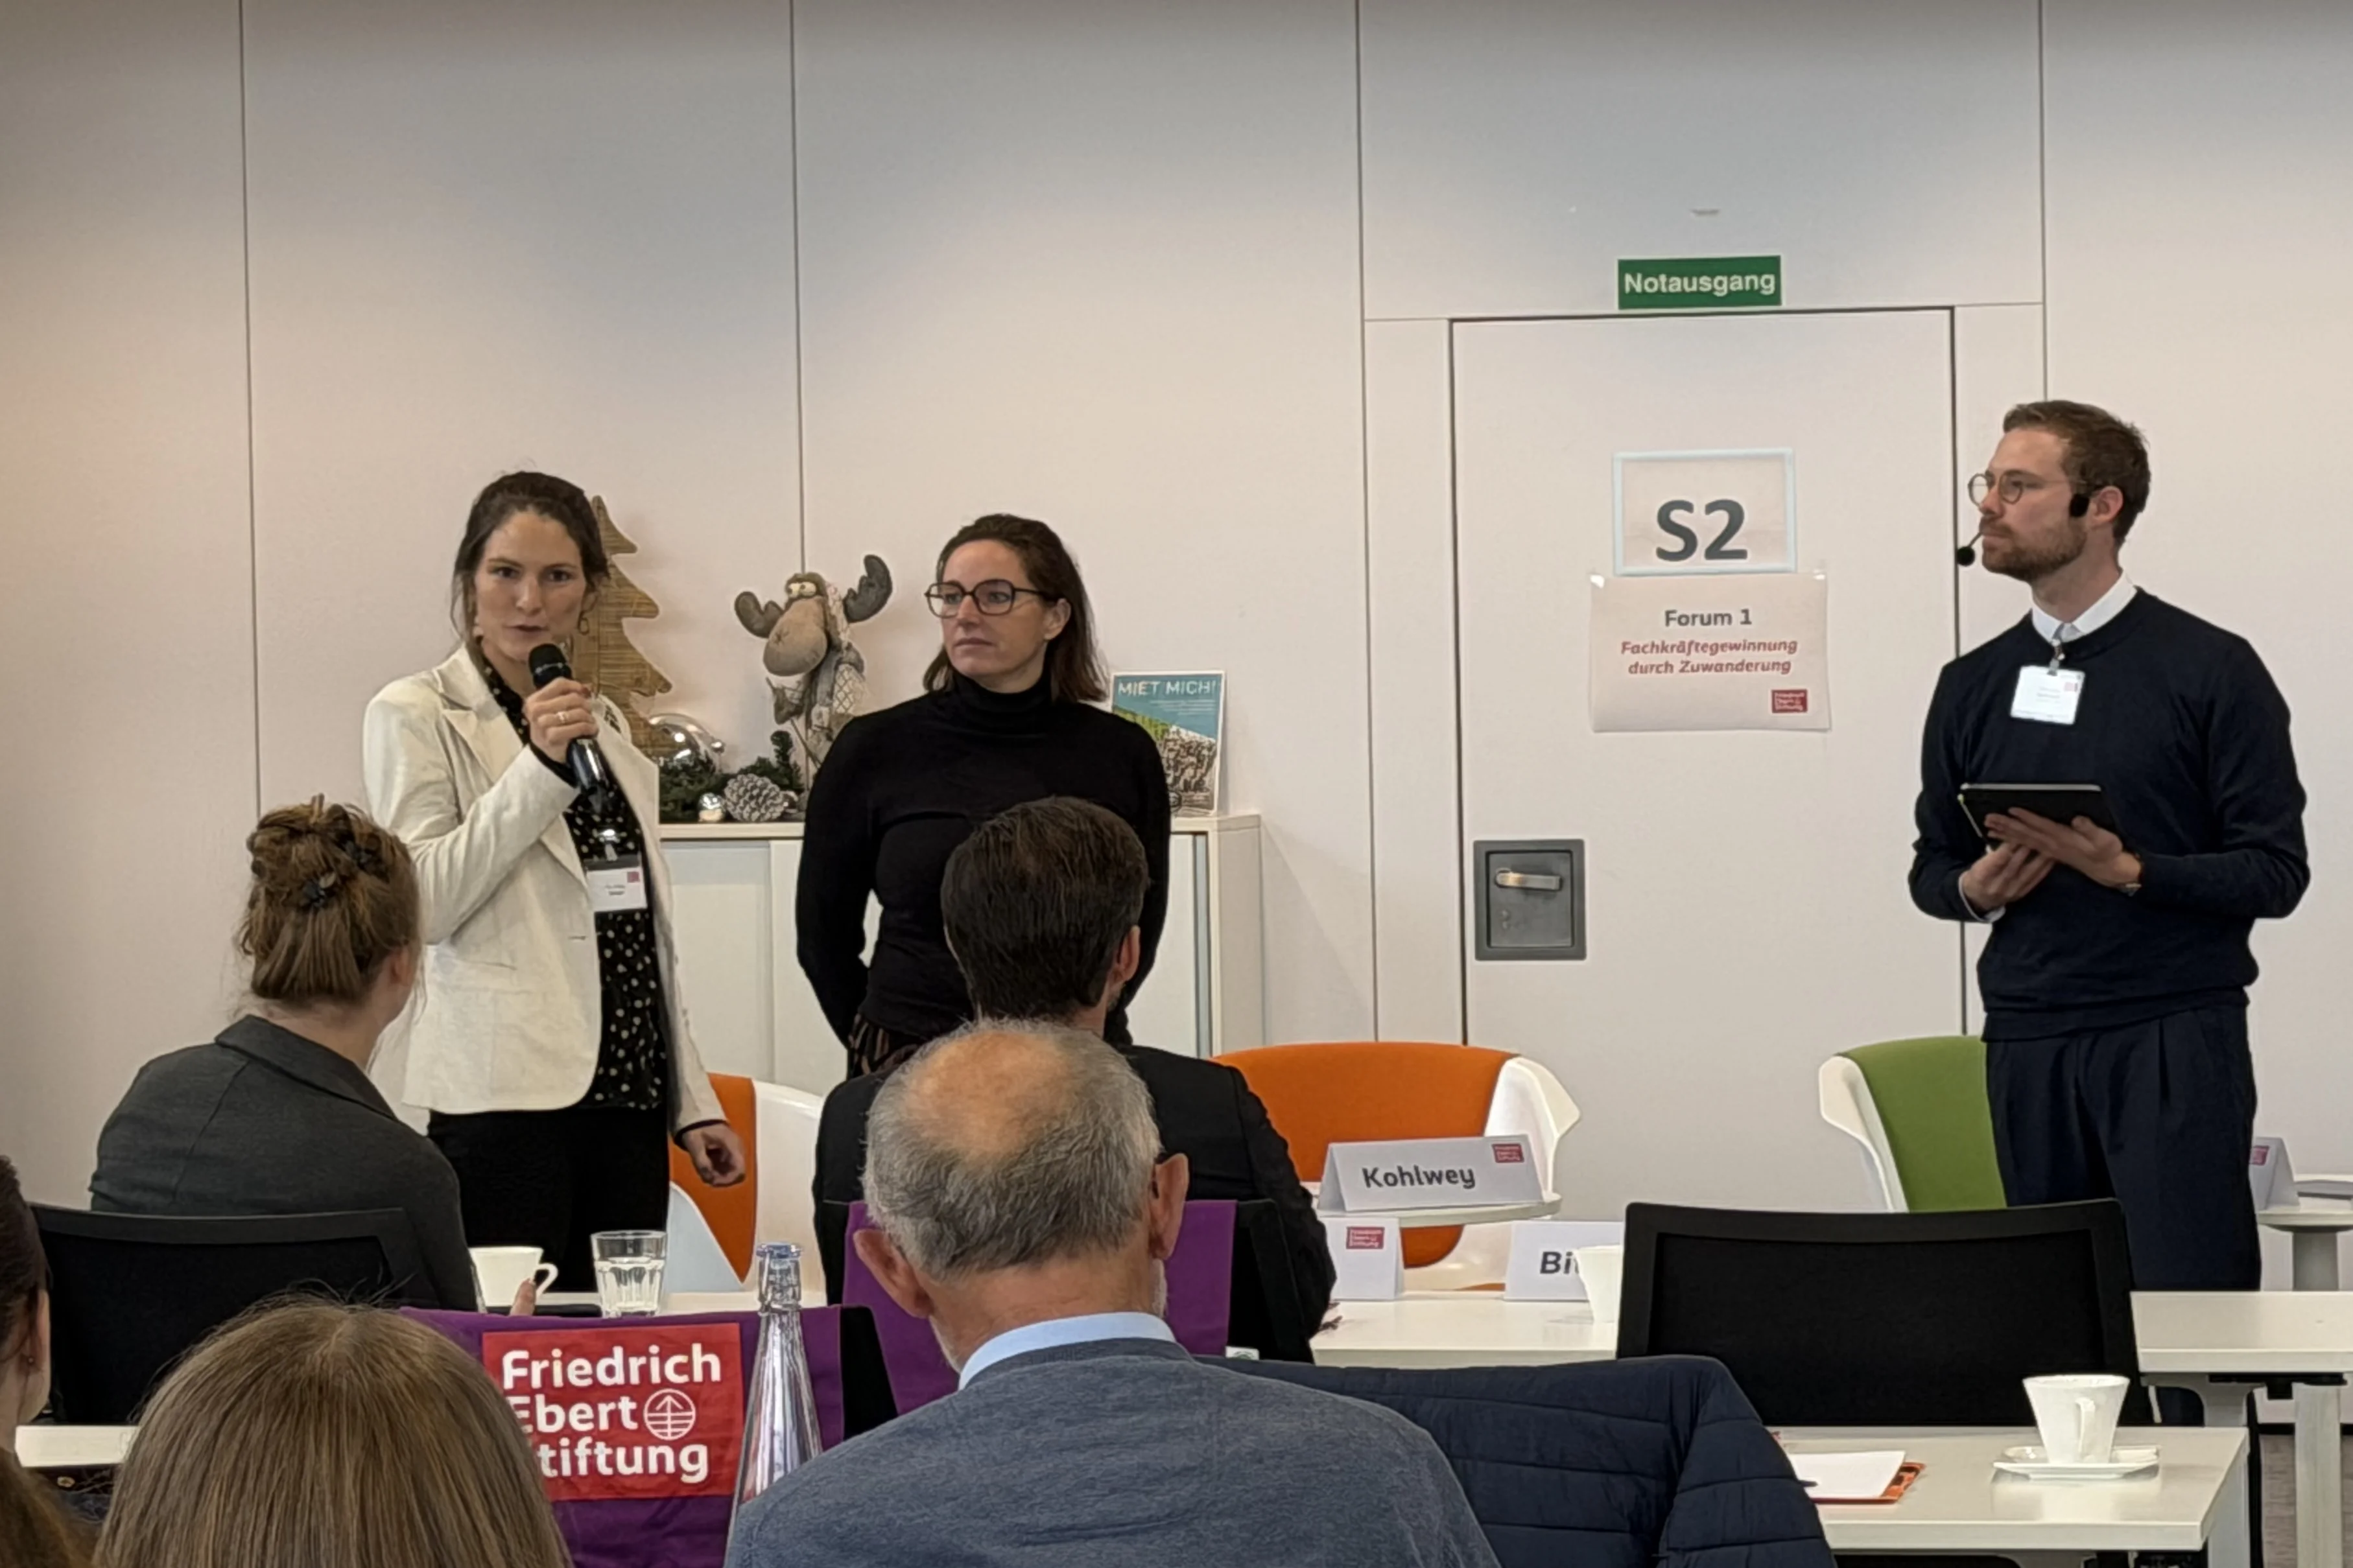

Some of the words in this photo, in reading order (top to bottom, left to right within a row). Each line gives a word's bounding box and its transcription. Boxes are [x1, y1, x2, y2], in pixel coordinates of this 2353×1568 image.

[1625, 272, 1775, 297] Notausgang
[1655, 498, 1748, 562] S2
[1664, 609, 1732, 627] Forum
[1740, 609, 1753, 626] 1
[1621, 638, 1798, 657] Fachkräftegewinnung
[1628, 661, 1674, 674] durch
[1678, 659, 1791, 675] Zuwanderung
[1118, 681, 1161, 696] MIET
[1166, 680, 1216, 695] MICH!
[1362, 1165, 1476, 1189] Kohlwey
[502, 1342, 721, 1390] Friedrich
[528, 1436, 709, 1484] tiftung
